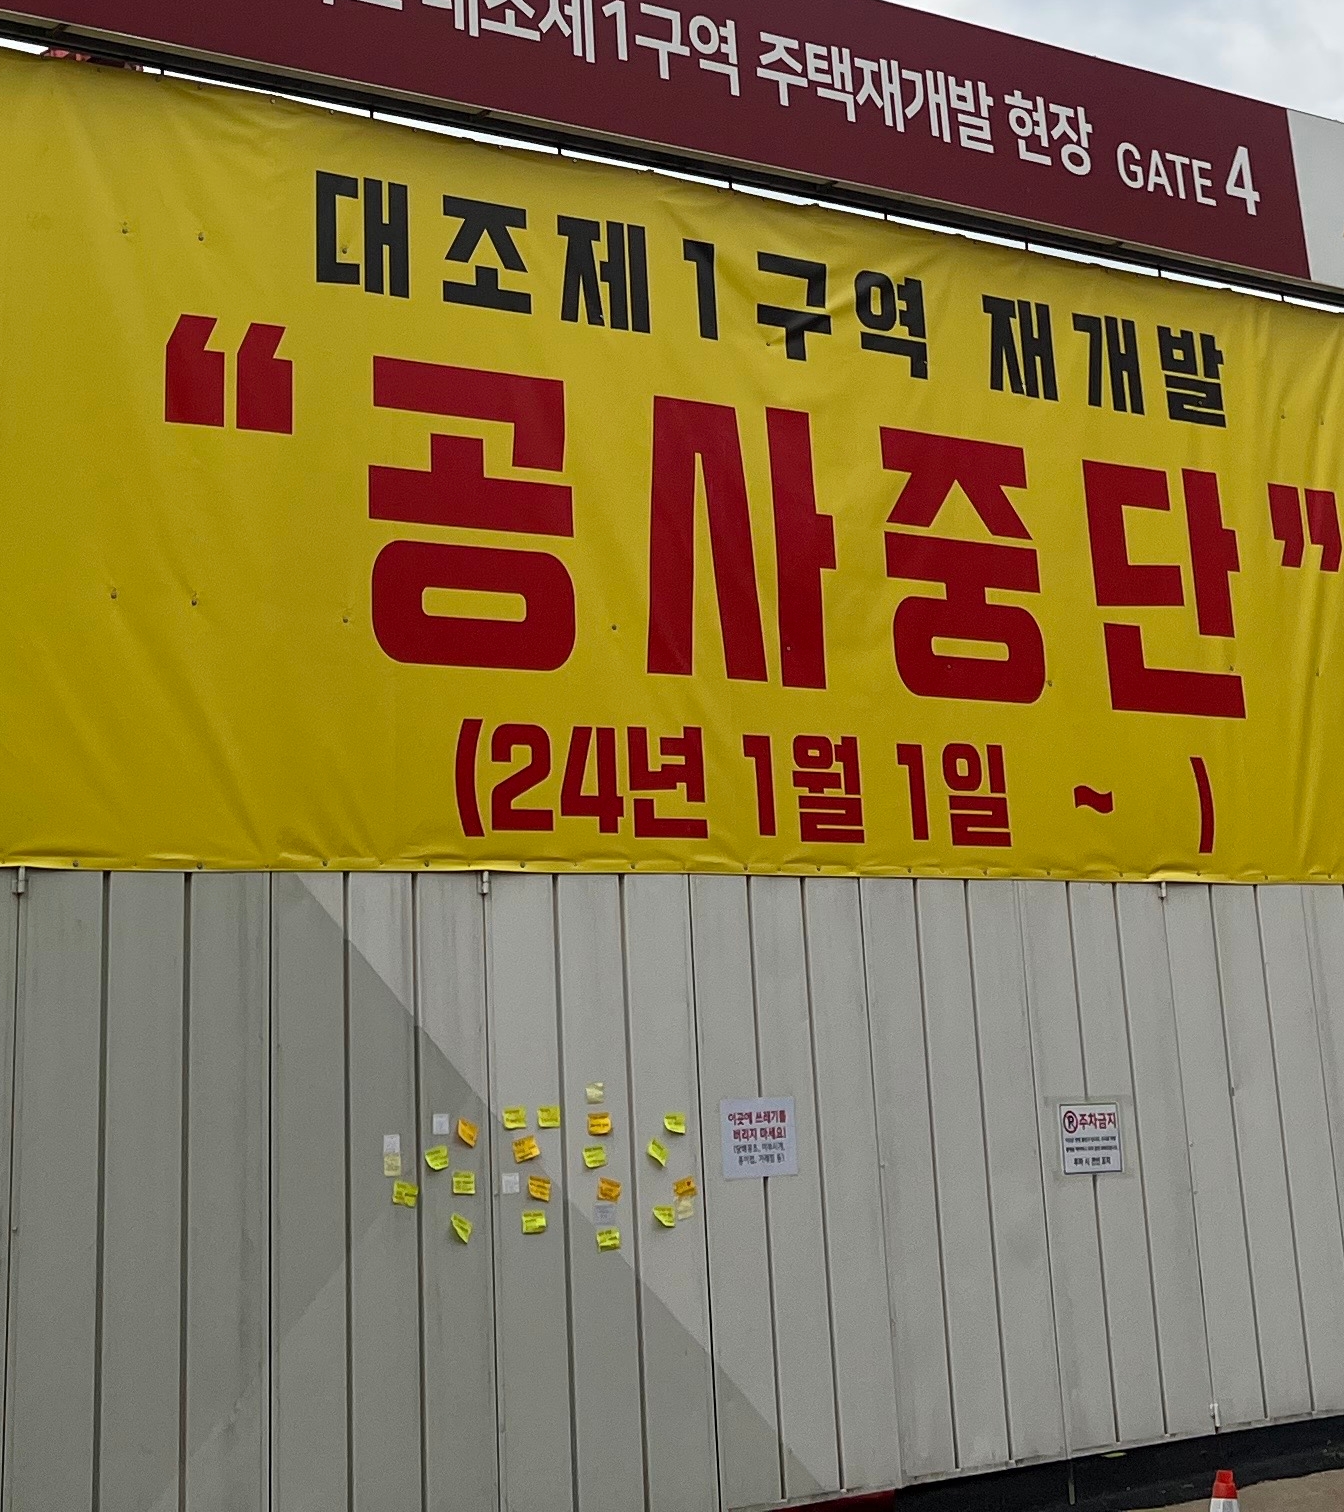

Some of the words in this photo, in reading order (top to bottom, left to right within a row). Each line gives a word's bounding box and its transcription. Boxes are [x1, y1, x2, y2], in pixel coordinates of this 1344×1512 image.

[756, 30, 995, 155] 주택재개발
[1005, 88, 1093, 177] 현장
[1115, 140, 1217, 208] GATE
[1225, 144, 1260, 216] 4
[981, 293, 1227, 429] 재개발
[454, 717, 710, 840] (24년
[742, 733, 866, 845] 1월
[896, 741, 1013, 848] 1일
[728, 1110, 753, 1126] 이곳에
[755, 1109, 786, 1124] 쓰레기를
[1079, 1112, 1116, 1130] 주차금지
